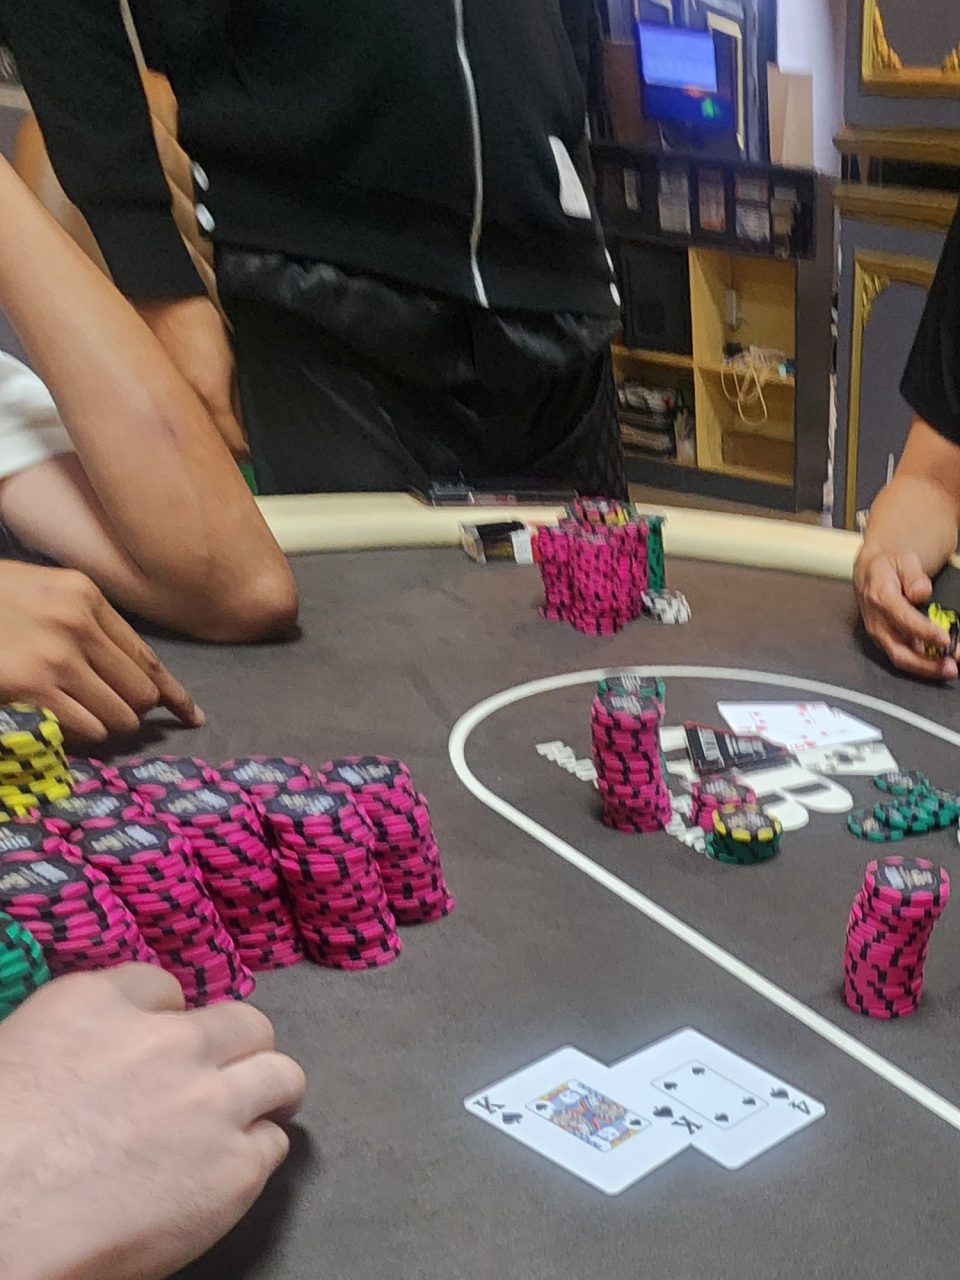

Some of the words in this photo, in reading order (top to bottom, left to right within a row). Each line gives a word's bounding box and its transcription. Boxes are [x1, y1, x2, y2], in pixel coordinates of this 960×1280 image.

[472, 1095, 505, 1115] K
[788, 1100, 811, 1117] 4
[671, 1115, 703, 1136] K
